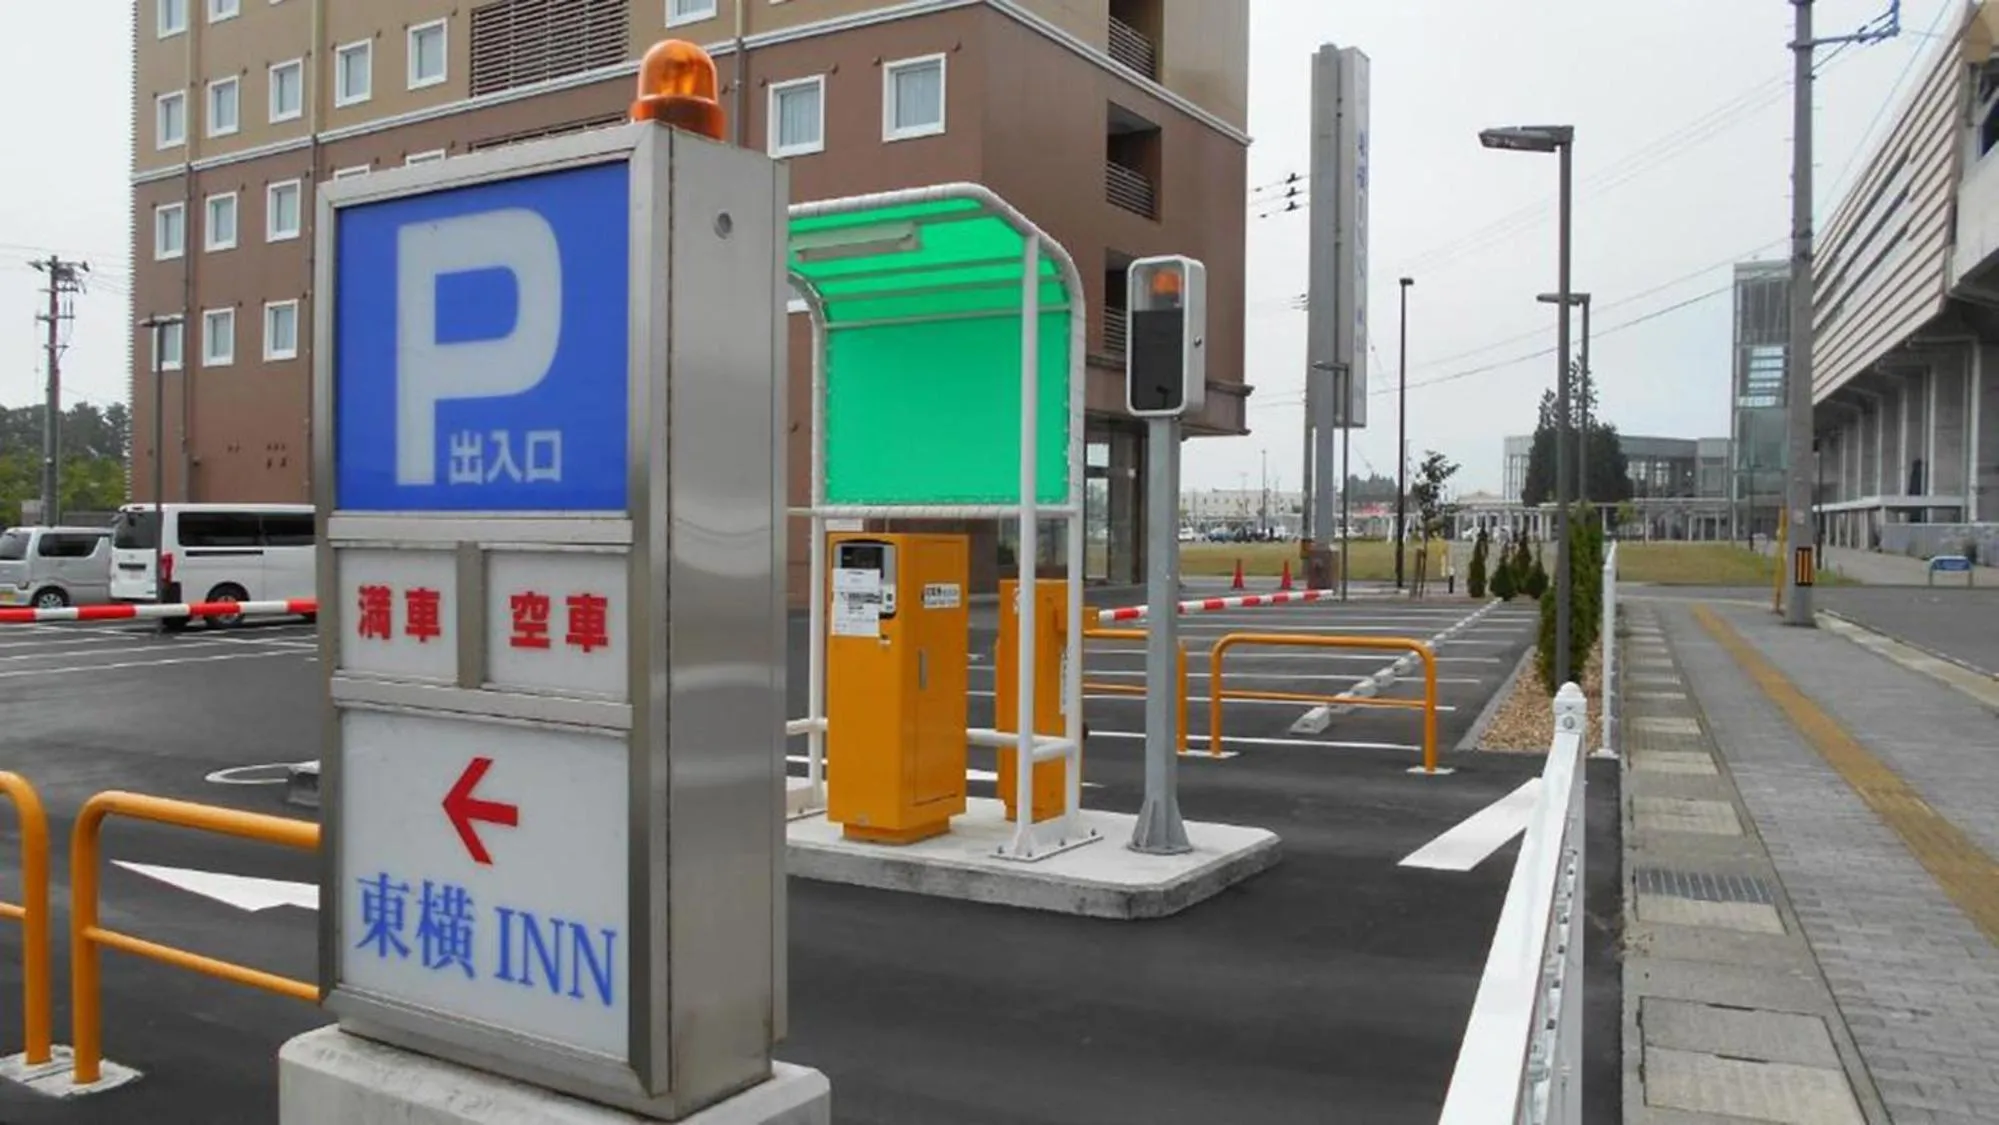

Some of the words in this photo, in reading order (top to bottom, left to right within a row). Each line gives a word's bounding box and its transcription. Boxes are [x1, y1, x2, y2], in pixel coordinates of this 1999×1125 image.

[397, 208, 562, 485] P
[450, 430, 562, 485] 出入口
[357, 584, 441, 643] 満車
[509, 590, 609, 652] 空車
[493, 906, 617, 1008] INN
